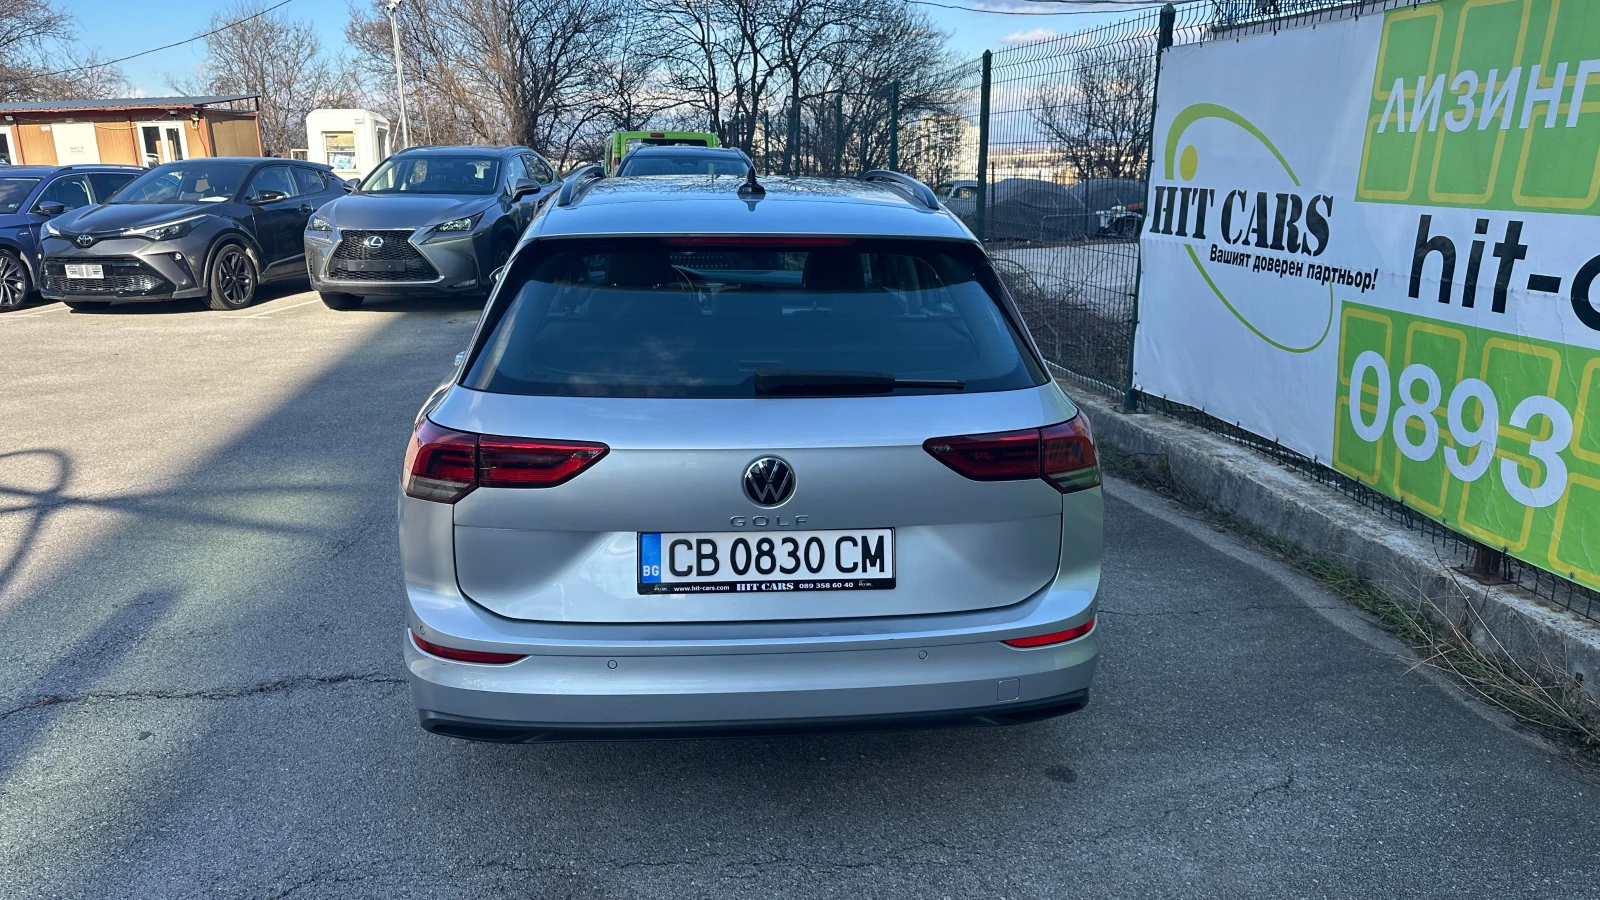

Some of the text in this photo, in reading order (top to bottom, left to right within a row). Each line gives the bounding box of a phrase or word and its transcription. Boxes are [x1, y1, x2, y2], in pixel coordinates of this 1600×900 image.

[1377, 59, 1600, 133] ЛИЗИНГ
[1149, 185, 1333, 257] HIT CARS
[1210, 243, 1379, 293] Вашият доверен партньор!
[1350, 350, 1573, 508] 0893
[730, 515, 809, 527] GOLF
[642, 565, 660, 577] BG
[669, 535, 885, 577] CB 0830 CM
[673, 584, 730, 592] www.hit-cars.com
[736, 583, 759, 591] HIT
[761, 582, 794, 591] CARS
